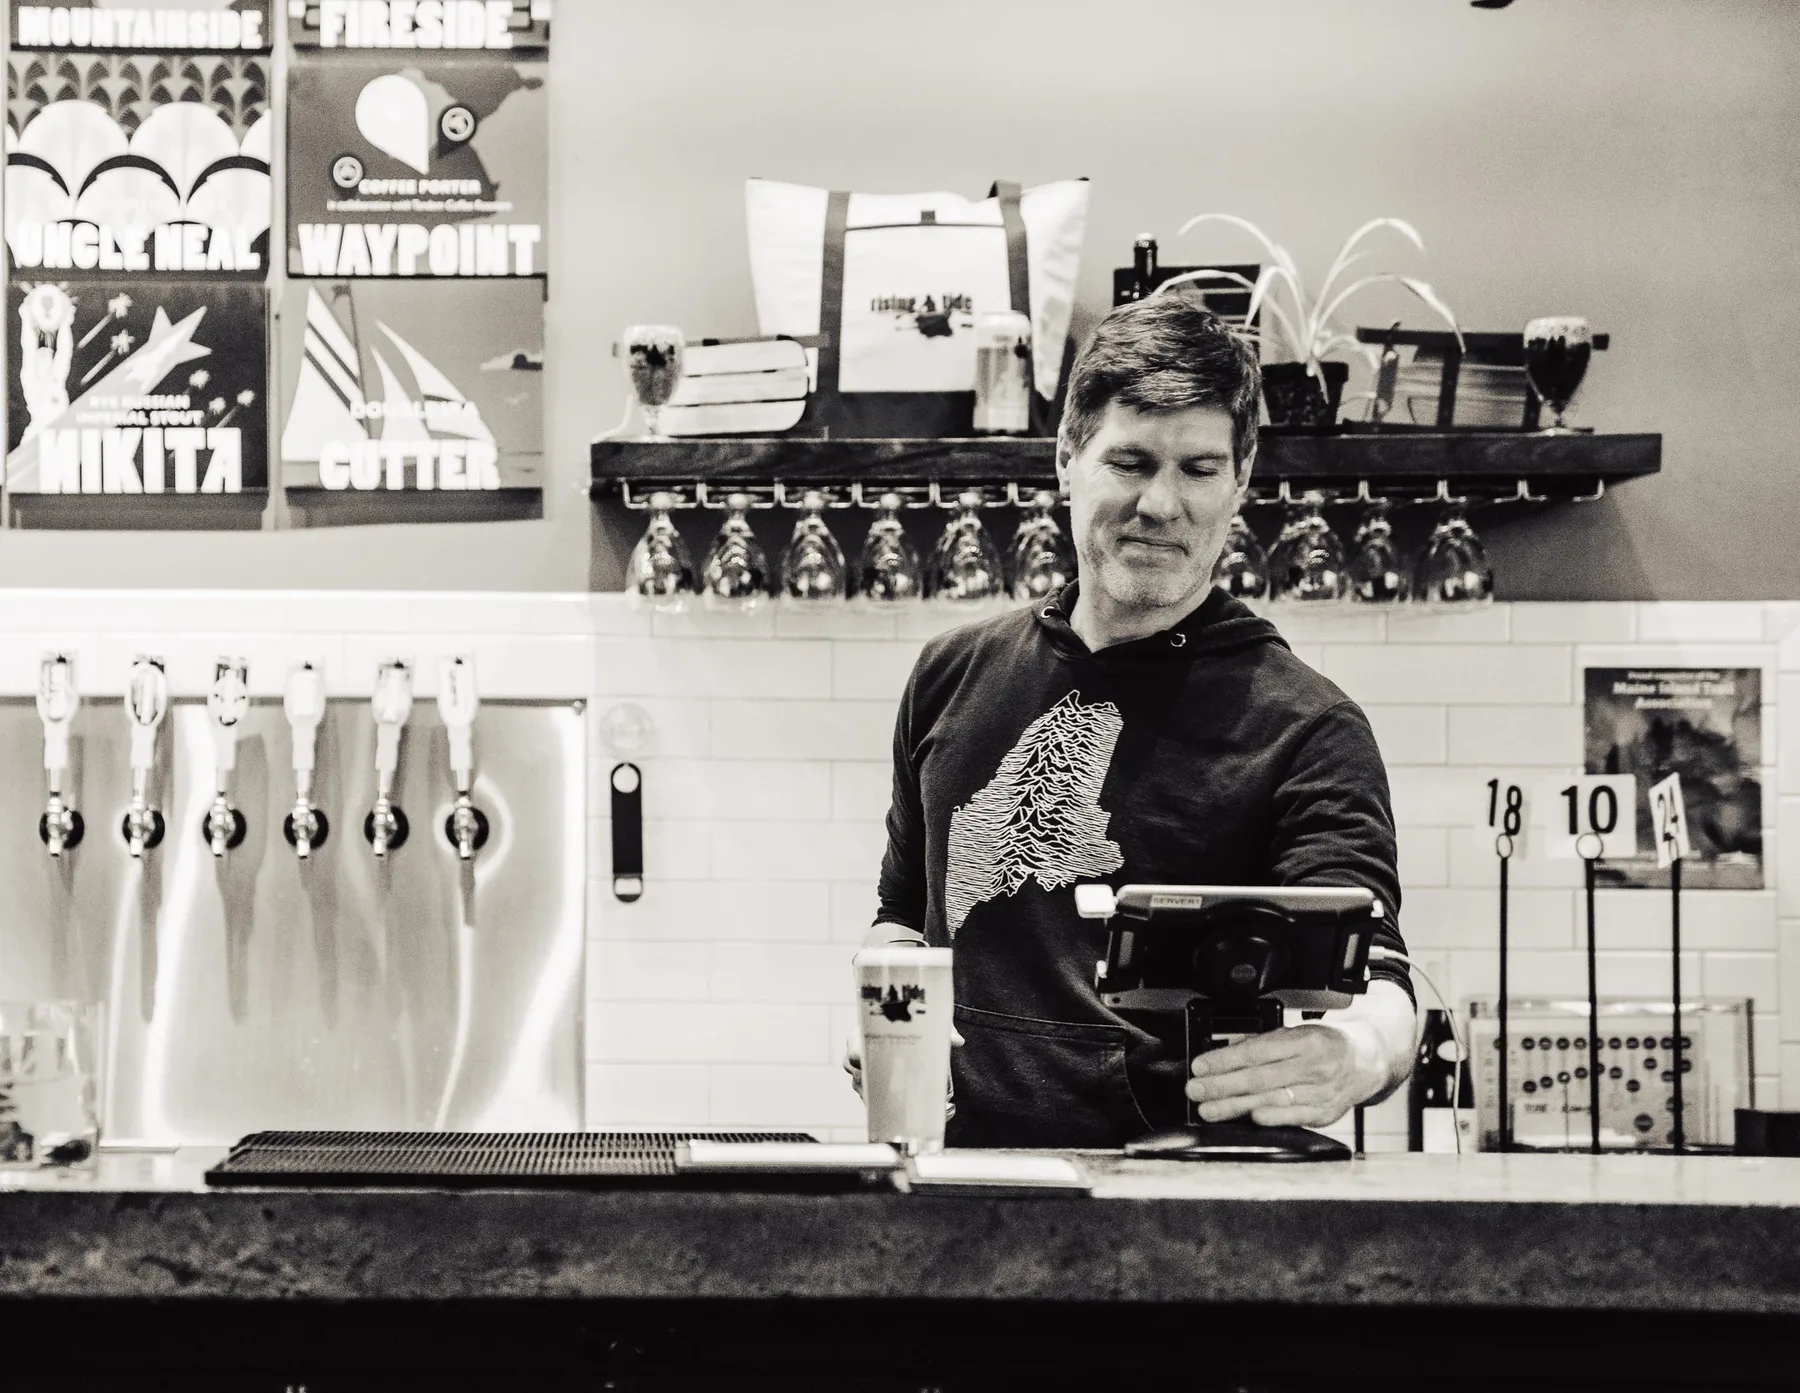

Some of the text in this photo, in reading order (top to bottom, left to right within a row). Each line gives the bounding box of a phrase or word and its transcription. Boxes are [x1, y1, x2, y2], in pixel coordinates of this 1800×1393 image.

[18, 6, 263, 49] MOUNTAINSIDE
[319, 0, 514, 49] FIRESIDE
[15, 221, 261, 271] UNCLE NEAL
[297, 223, 541, 276] WAYPOINT
[39, 427, 242, 494] NIKITA
[319, 439, 501, 490] CUTTER
[1487, 778, 1523, 836] 18
[1560, 785, 1618, 835] 10
